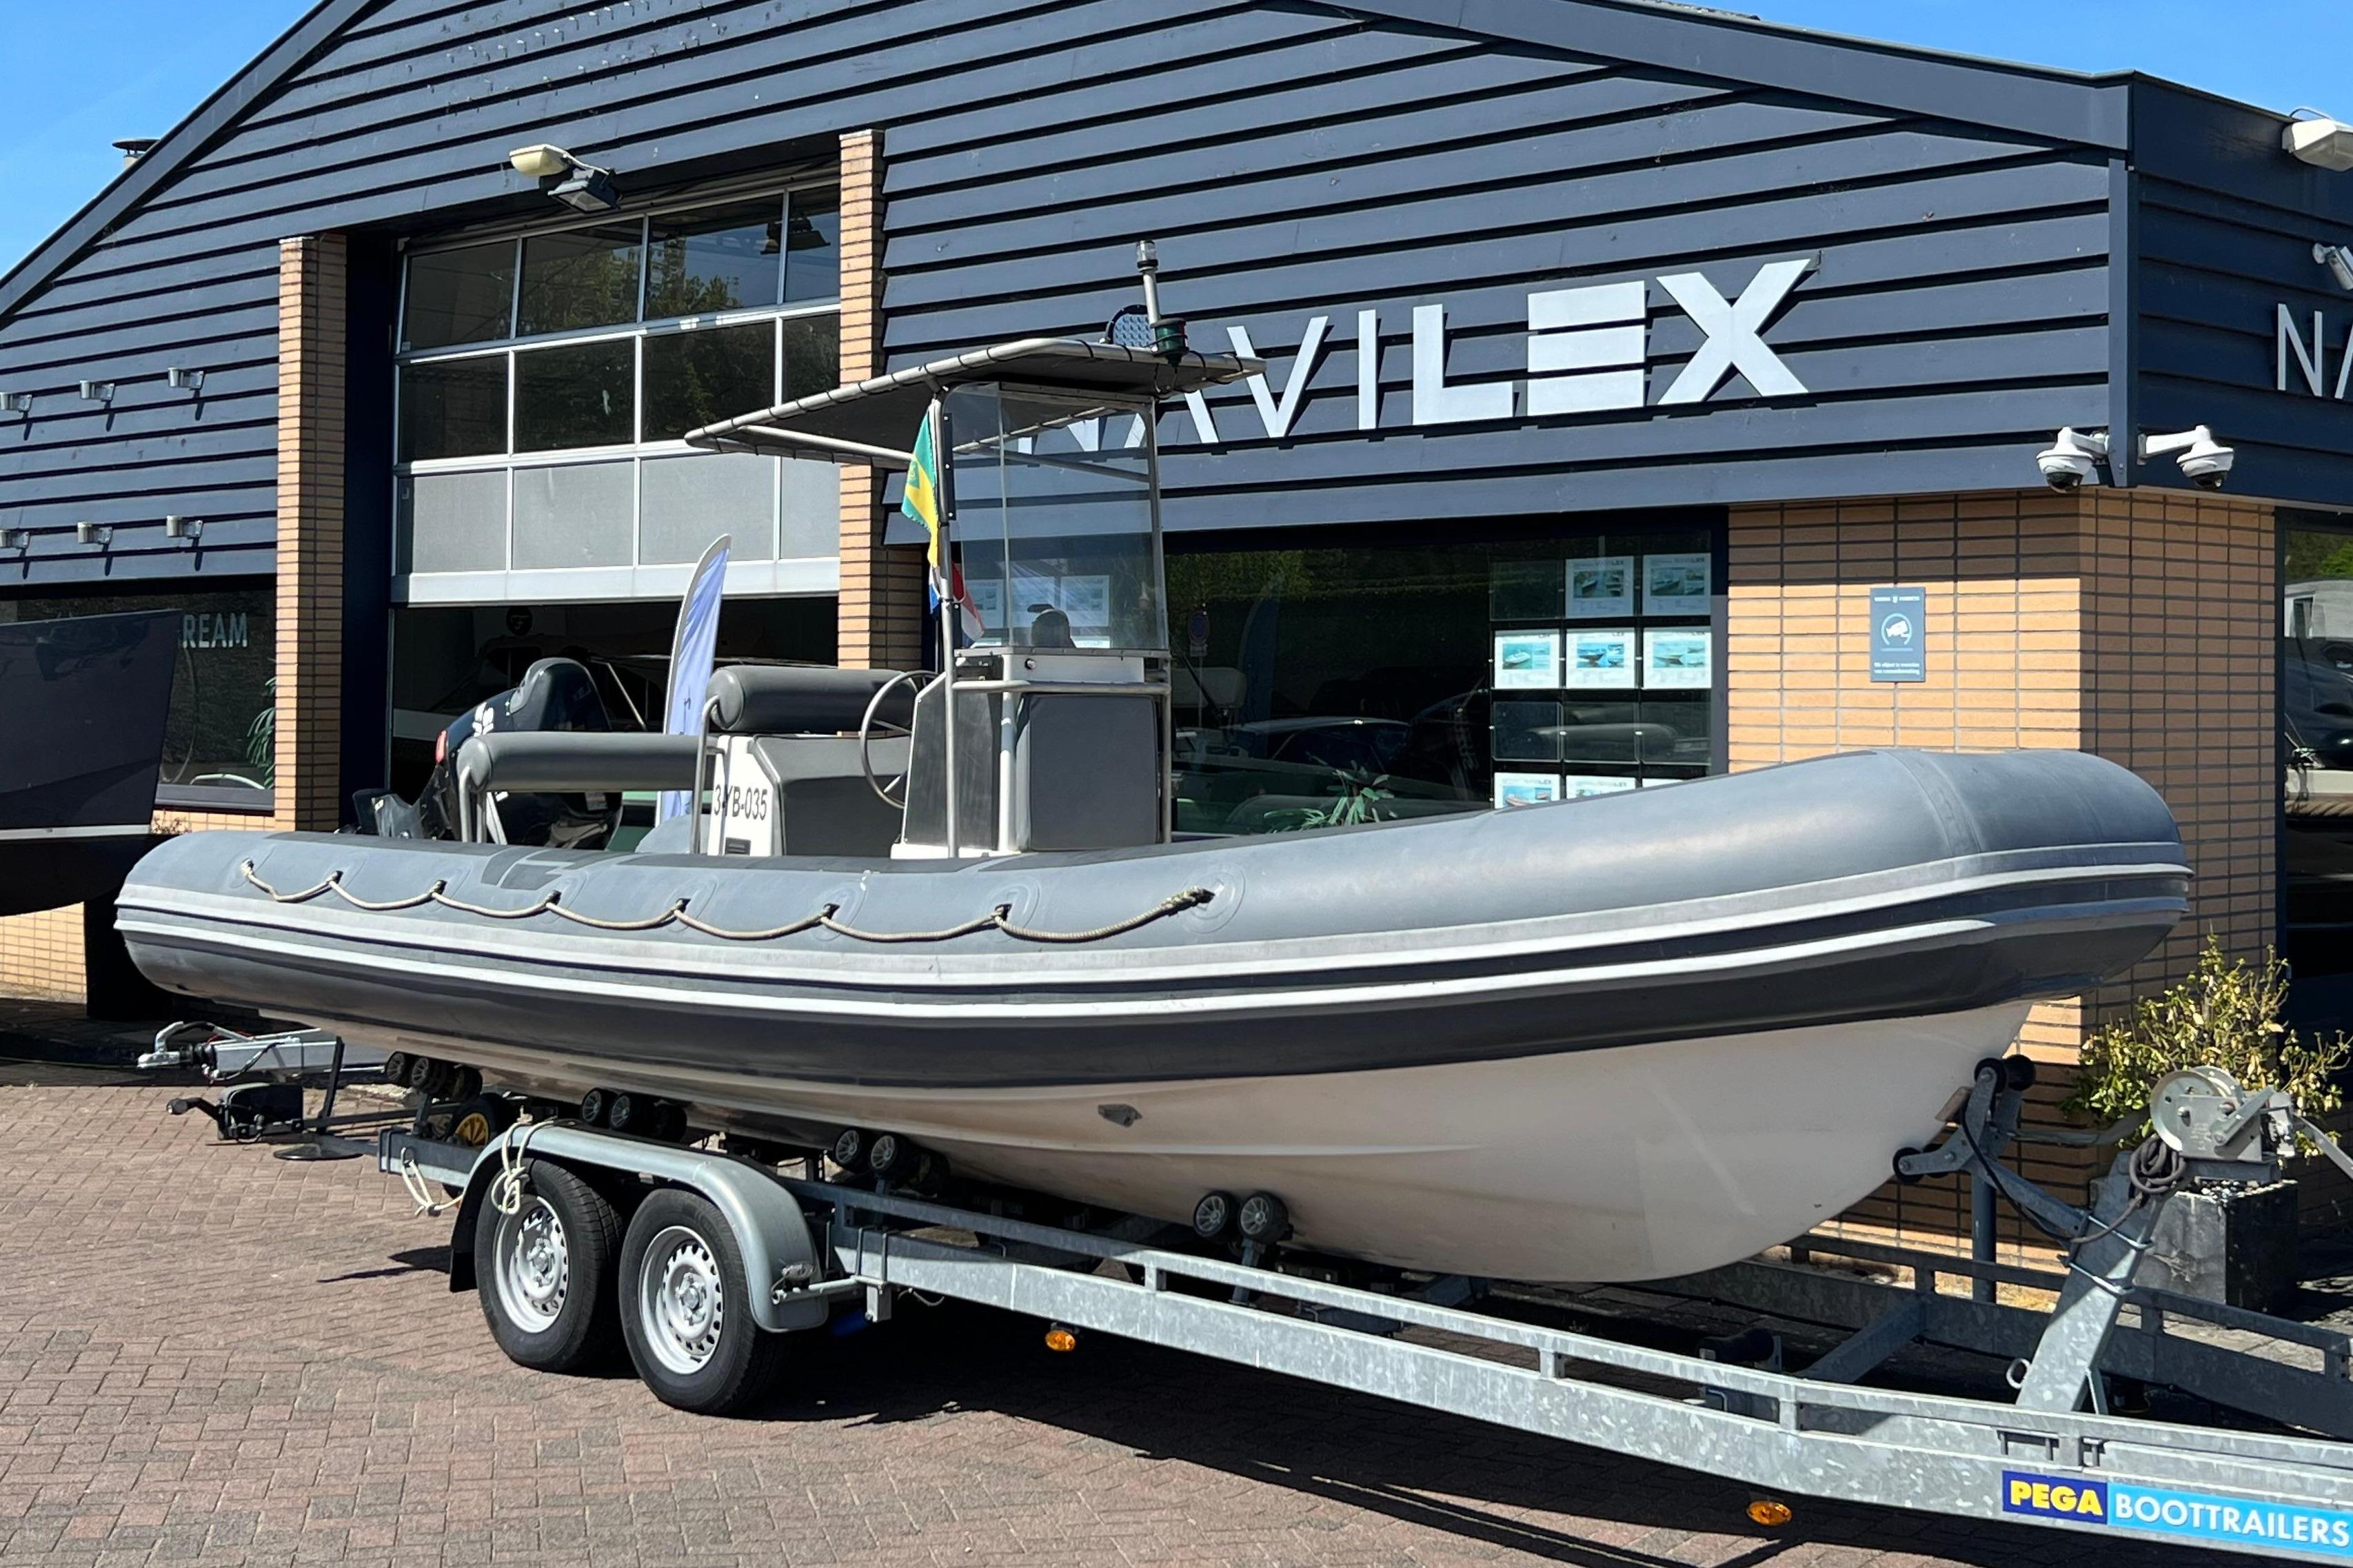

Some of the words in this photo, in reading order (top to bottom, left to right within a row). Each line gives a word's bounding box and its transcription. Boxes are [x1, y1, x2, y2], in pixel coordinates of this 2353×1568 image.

[183, 613, 248, 648] REAM
[2010, 1480, 2103, 1516] PEGA
[2115, 1493, 2350, 1547] BOOTTRAILERS
